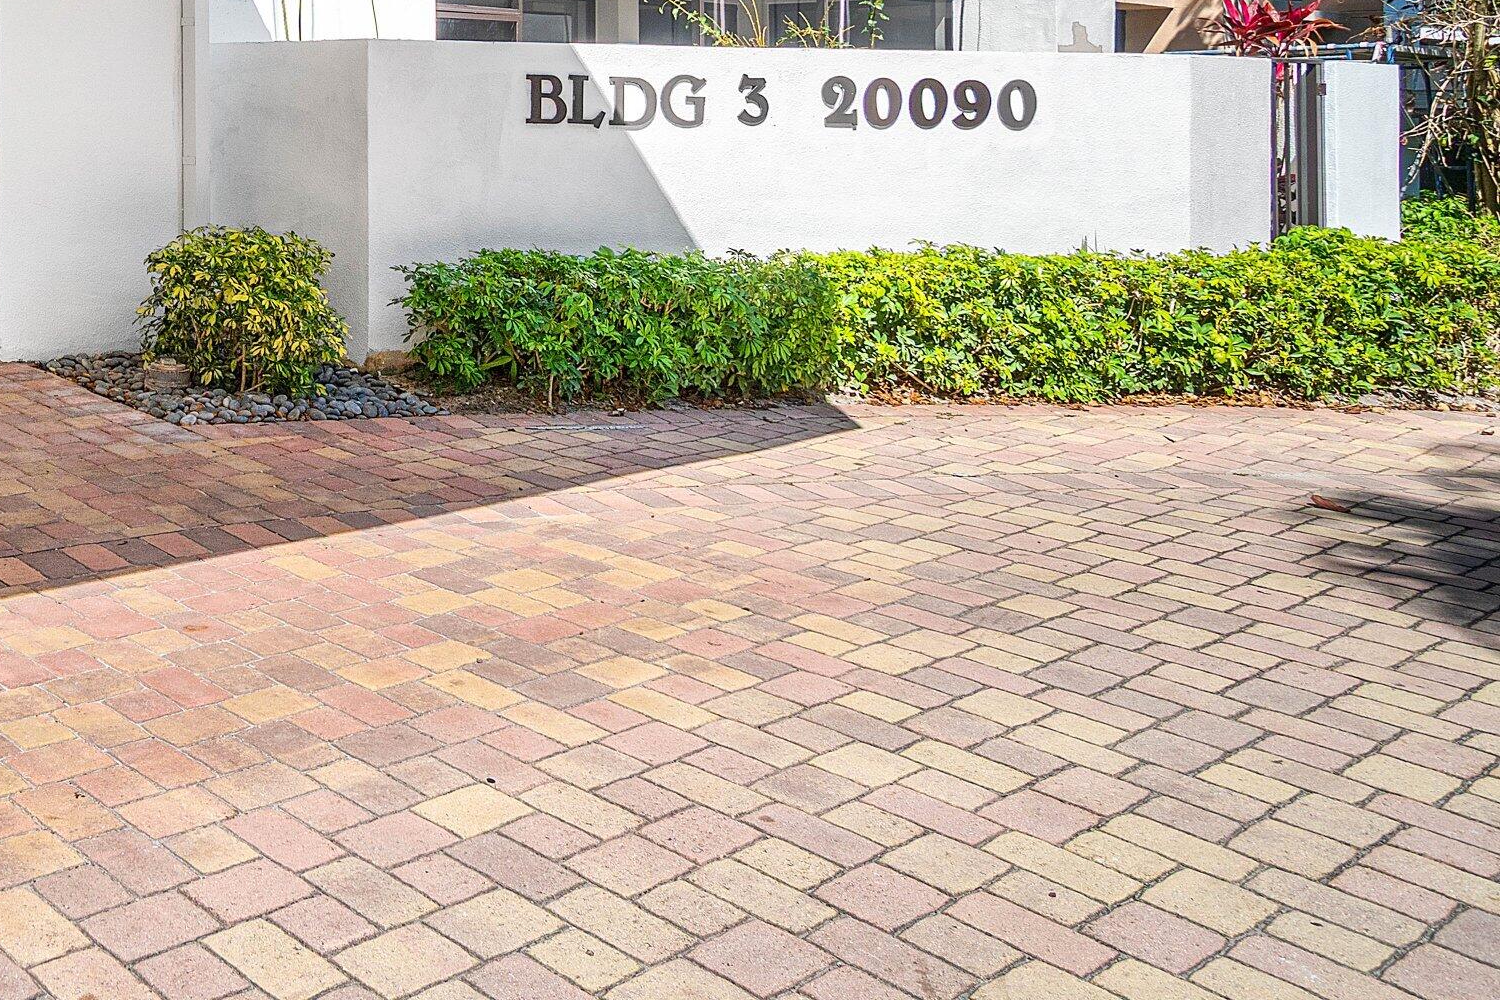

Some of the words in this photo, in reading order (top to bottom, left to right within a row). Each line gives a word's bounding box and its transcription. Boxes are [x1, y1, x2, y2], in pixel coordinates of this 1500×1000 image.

[525, 74, 707, 130] BLDG
[737, 74, 769, 127] 3
[821, 75, 1037, 131] 20090
